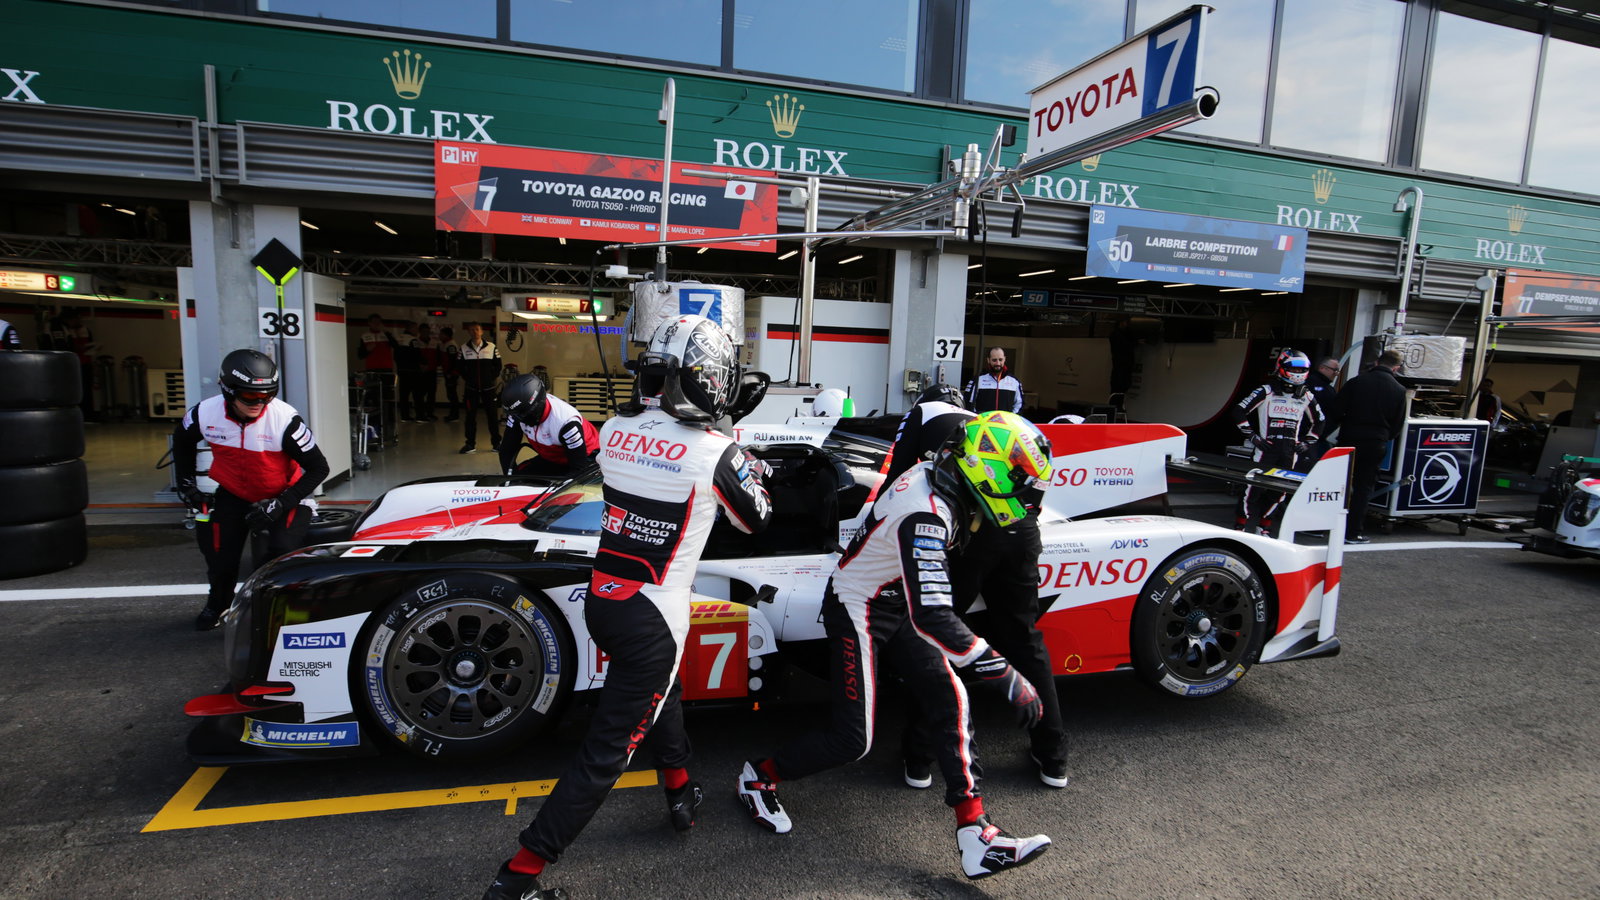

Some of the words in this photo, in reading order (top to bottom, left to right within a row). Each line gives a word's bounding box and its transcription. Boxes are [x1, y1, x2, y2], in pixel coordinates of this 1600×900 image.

[1034, 67, 1137, 137] TOYOTA
[1155, 18, 1192, 108] 7
[326, 100, 497, 144] ROLEX
[443, 148, 458, 160] P1
[461, 151, 477, 163] HY
[712, 138, 849, 177] ROLEX
[478, 185, 497, 211] 7
[522, 180, 585, 197] TOYOTA
[590, 185, 645, 203] GAZOO
[1034, 175, 1139, 208] ROLEX
[571, 199, 599, 209] TOYOTA
[601, 201, 623, 211] TS050
[630, 204, 656, 213] HYBRID
[533, 216, 548, 224] MIKE
[549, 217, 572, 225] CONWAY
[1093, 211, 1105, 222] P2
[1276, 204, 1362, 233] ROLEX
[591, 220, 609, 228] KAMUI
[610, 222, 640, 230] KOBAYASHI
[1108, 241, 1132, 262] 50
[1146, 236, 1187, 249] LARBRE
[1190, 241, 1258, 257] COMPETITION
[1475, 239, 1547, 265] ROLEX
[1189, 252, 1207, 260] JSP217
[1210, 254, 1228, 262] GIBSON
[46, 276, 58, 289] 8
[528, 299, 536, 309] 7
[581, 301, 589, 311] 7
[689, 293, 715, 319] 7
[1028, 293, 1043, 303] 50
[1518, 296, 1534, 313] 77
[1534, 291, 1599, 306] DEMPSEY-PROTON
[262, 312, 300, 337] 38
[533, 324, 577, 334] TOYOTA
[580, 325, 626, 335] HYBRI
[694, 333, 719, 356] Arai
[935, 339, 962, 358] 37
[1273, 405, 1299, 413] DENSO
[607, 430, 688, 461] DENSO
[769, 433, 796, 442] AISIN
[1430, 433, 1472, 442] LARBRE
[1020, 433, 1046, 468] DENSO
[605, 449, 635, 463] TOYOTA
[636, 456, 682, 474] HYBRID
[1095, 467, 1134, 477] TOYOTA
[451, 496, 491, 504] HYBRID
[493, 490, 500, 499] 7
[1308, 491, 1341, 504] JTEKT
[601, 511, 623, 533] GR
[625, 521, 670, 538] GAZOO
[629, 512, 678, 531] TOYOTA
[623, 529, 666, 546] Racing
[1110, 538, 1149, 550] ADVICS
[1184, 555, 1225, 570] MICHELIN
[422, 585, 443, 600] 761
[1150, 589, 1167, 605] RL
[287, 635, 341, 647] AISIN
[535, 618, 558, 673] MICHELIN
[283, 661, 332, 669] MITSUBISHI
[700, 632, 737, 690] 7
[841, 636, 858, 701] DENSO
[280, 669, 320, 677] ELECTRIC
[1188, 679, 1229, 695] MICHELIN
[368, 670, 395, 725] MICHELIN
[267, 730, 347, 741] MICHELIN
